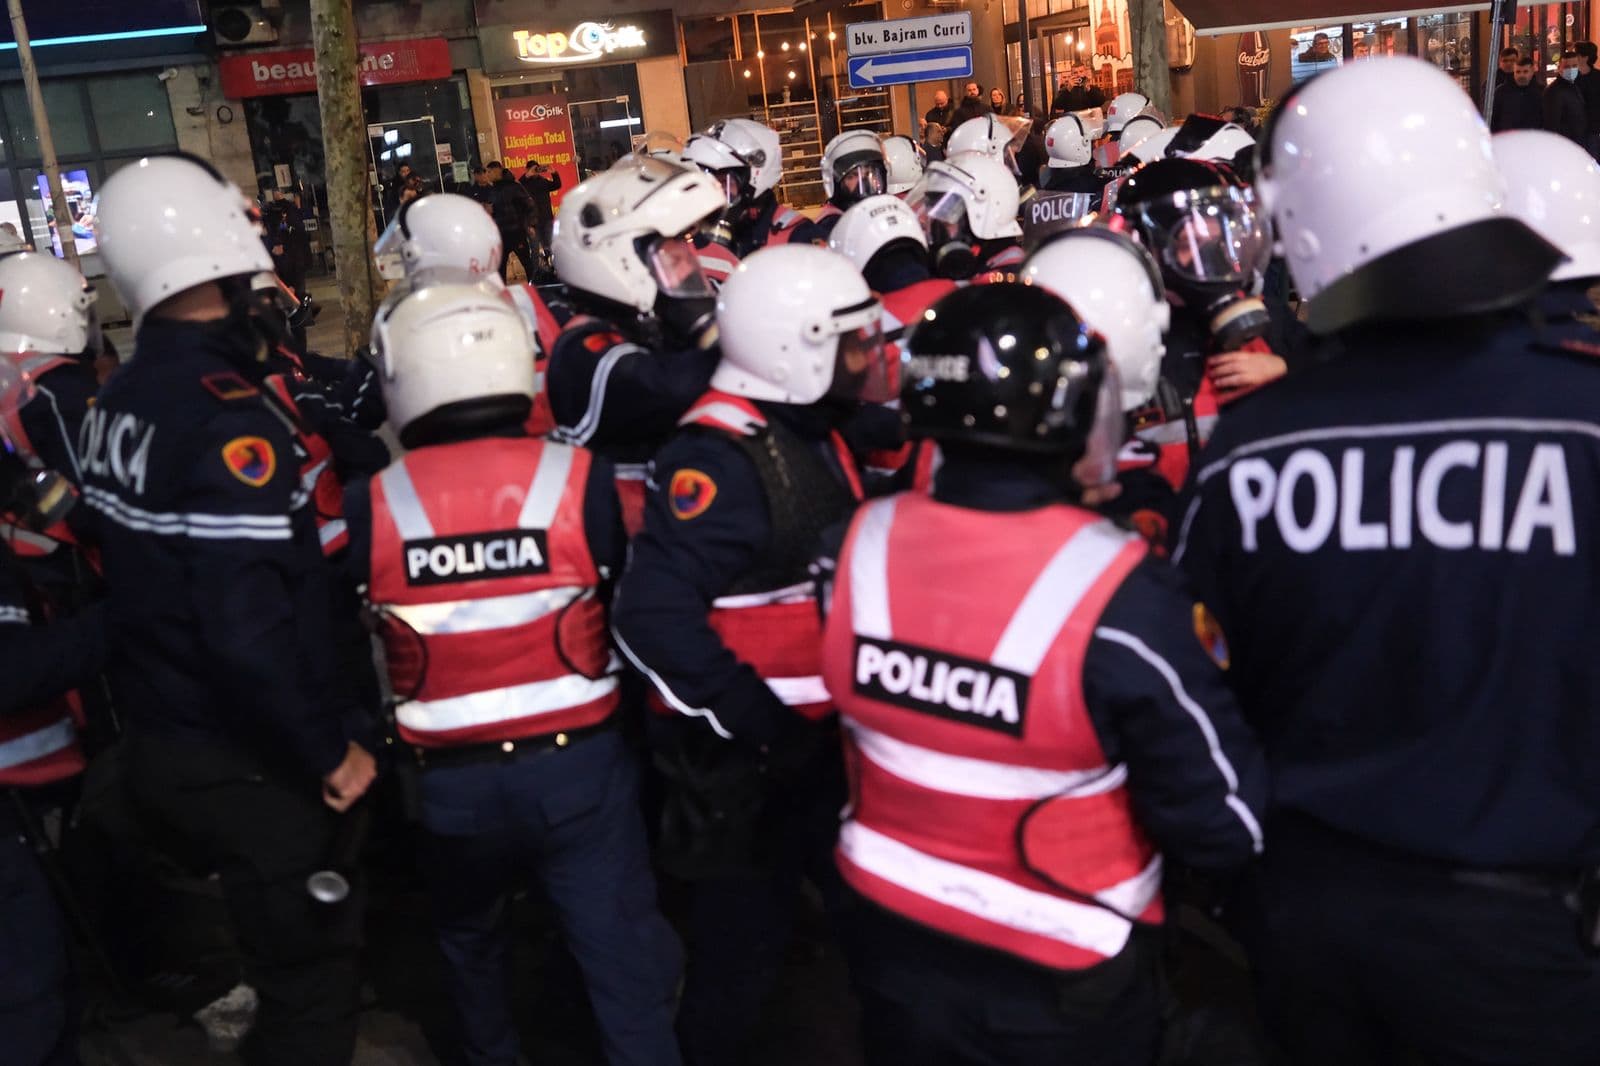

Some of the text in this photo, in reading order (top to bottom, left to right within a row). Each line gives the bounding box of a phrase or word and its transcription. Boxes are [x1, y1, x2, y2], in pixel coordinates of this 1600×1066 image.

[513, 30, 568, 58] Top
[854, 22, 965, 46] blv. Bajram Curri
[506, 109, 529, 121] Top
[543, 130, 567, 144] Total
[555, 152, 571, 166] nga
[1229, 440, 1576, 556] POLICIA
[406, 536, 544, 579] POLICIA
[856, 643, 1020, 724] POLICIA
